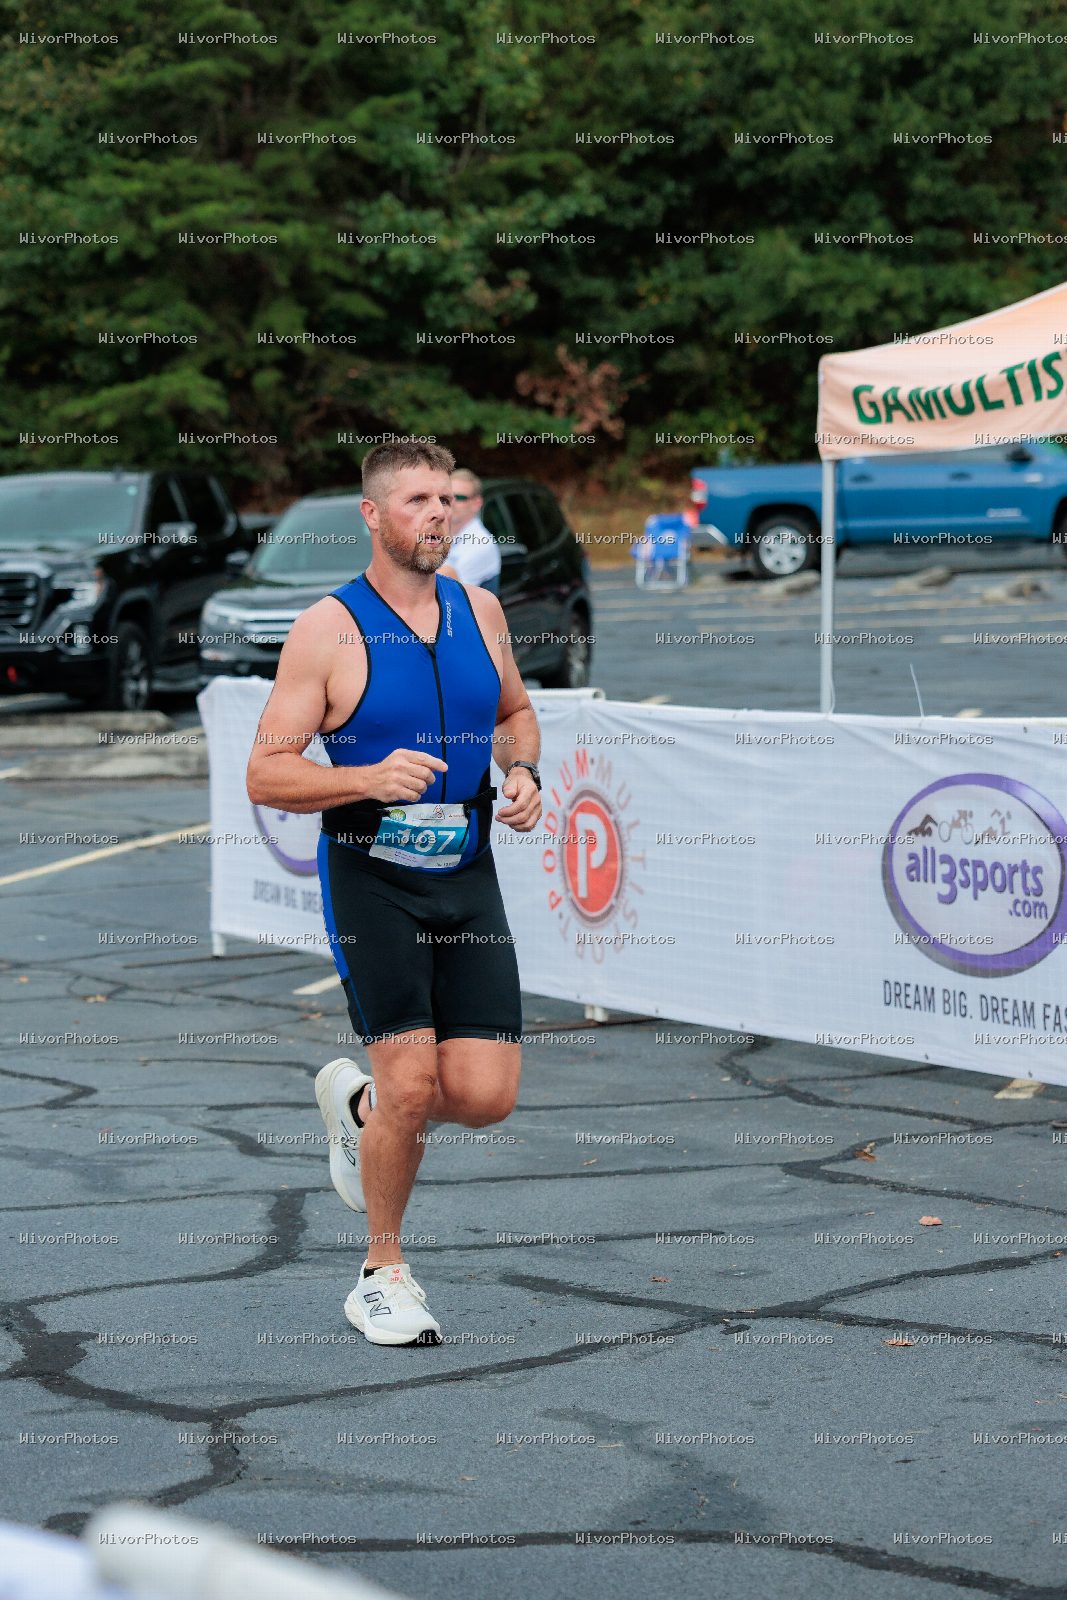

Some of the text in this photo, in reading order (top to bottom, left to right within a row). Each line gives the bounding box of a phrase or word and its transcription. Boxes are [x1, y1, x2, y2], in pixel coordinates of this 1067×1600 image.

[905, 846, 1044, 904] all3sports
[1008, 897, 1049, 920] .com
[883, 979, 936, 1014] DREAM
[942, 988, 973, 1020] BIG.
[979, 994, 1036, 1030] DREAM
